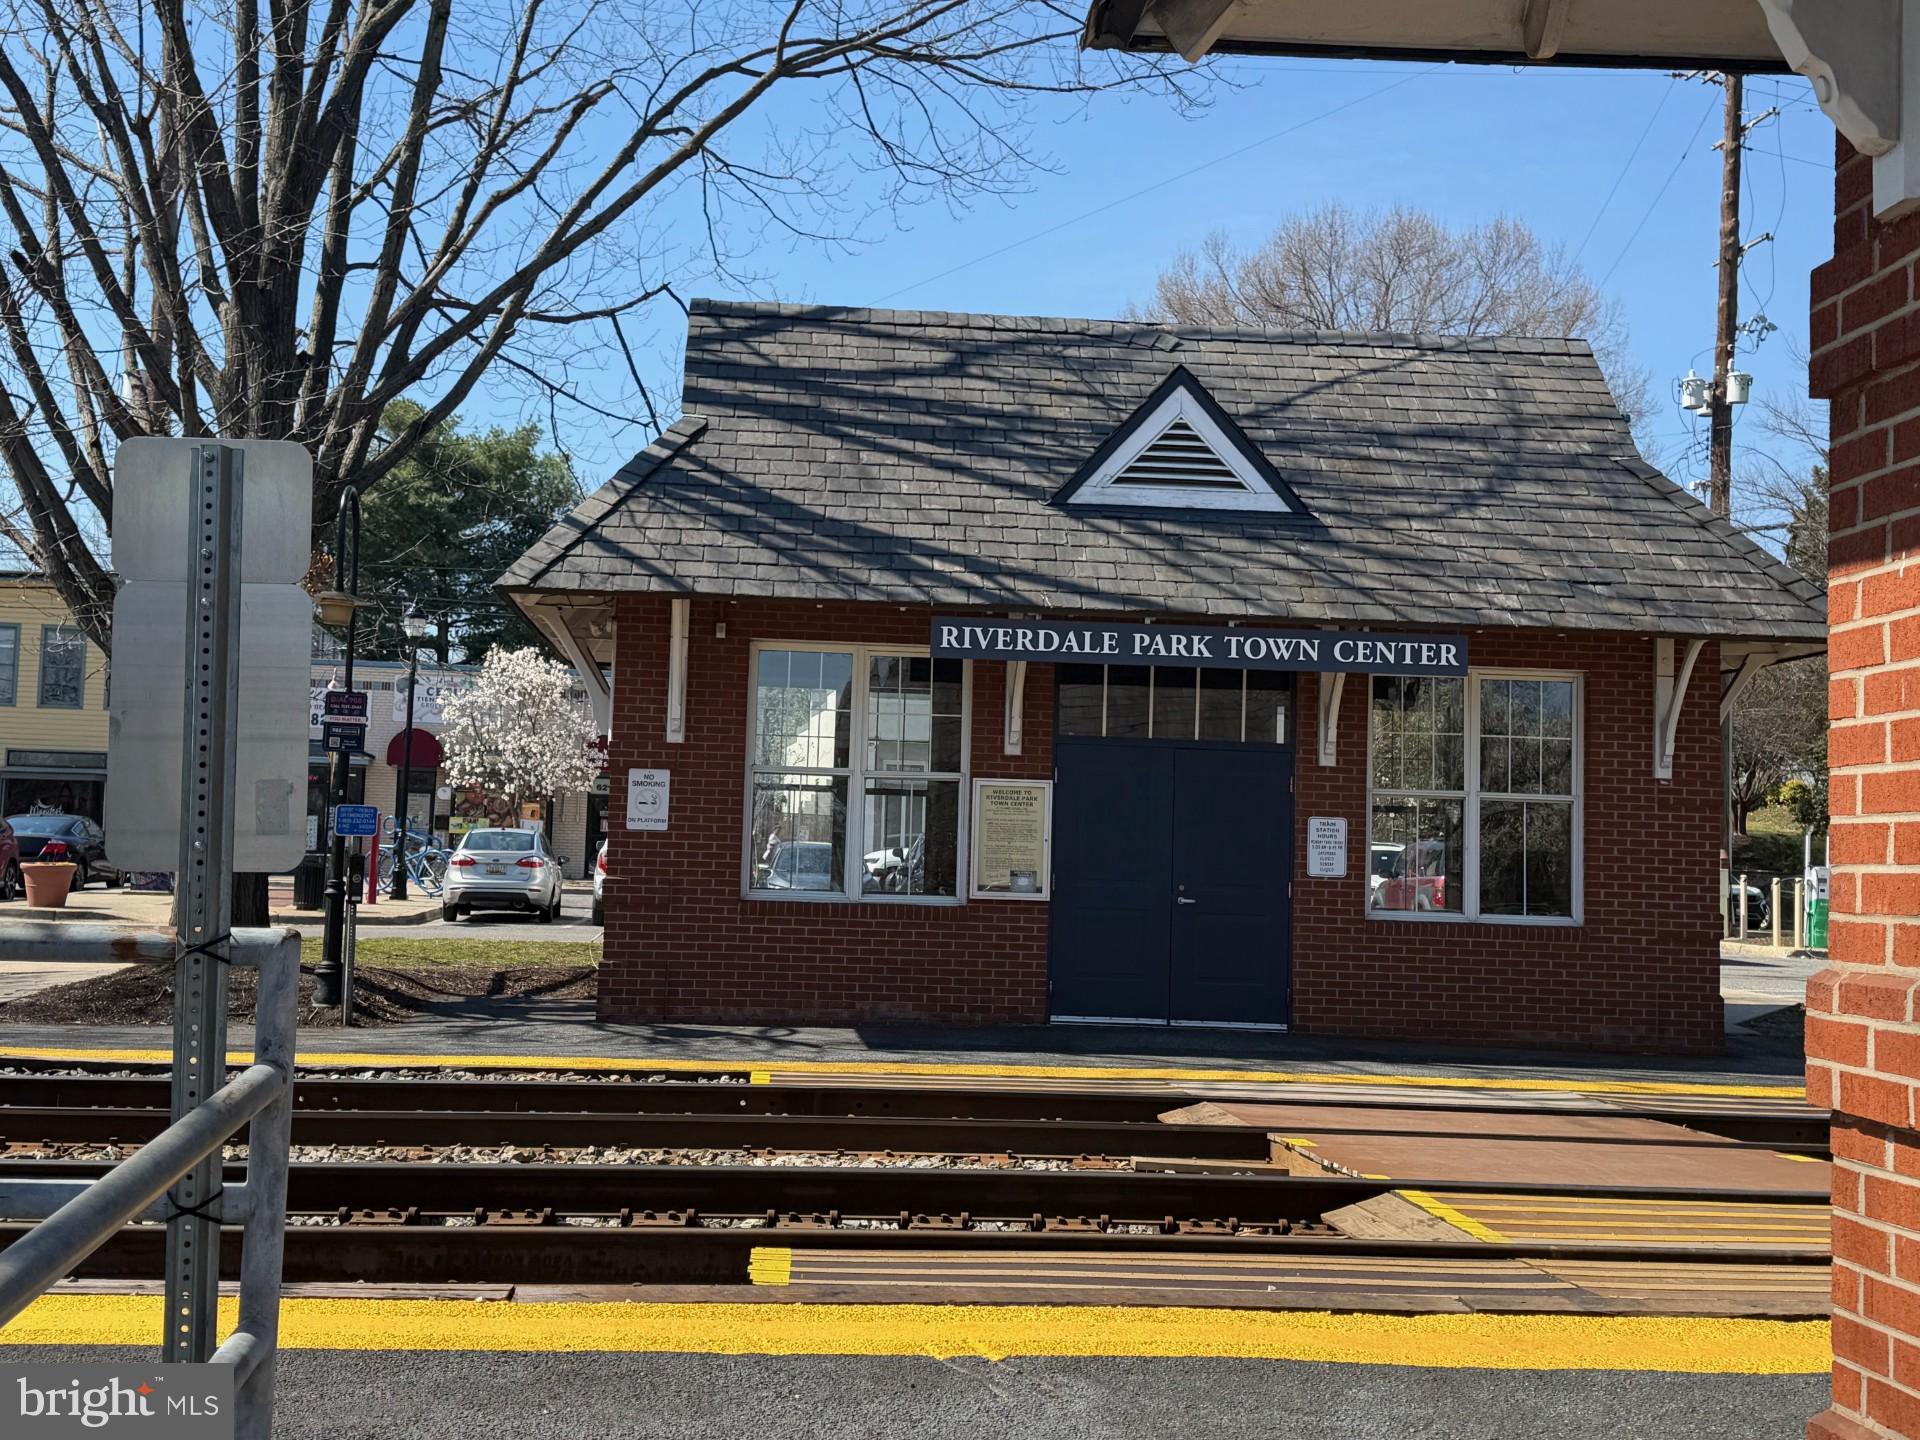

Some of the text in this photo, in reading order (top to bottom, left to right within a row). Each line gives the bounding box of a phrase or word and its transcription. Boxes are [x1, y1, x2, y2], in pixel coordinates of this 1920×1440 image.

[939, 625, 1460, 666] RIVERDALE PARK TOWN CENTER
[631, 780, 666, 788] SMOKING
